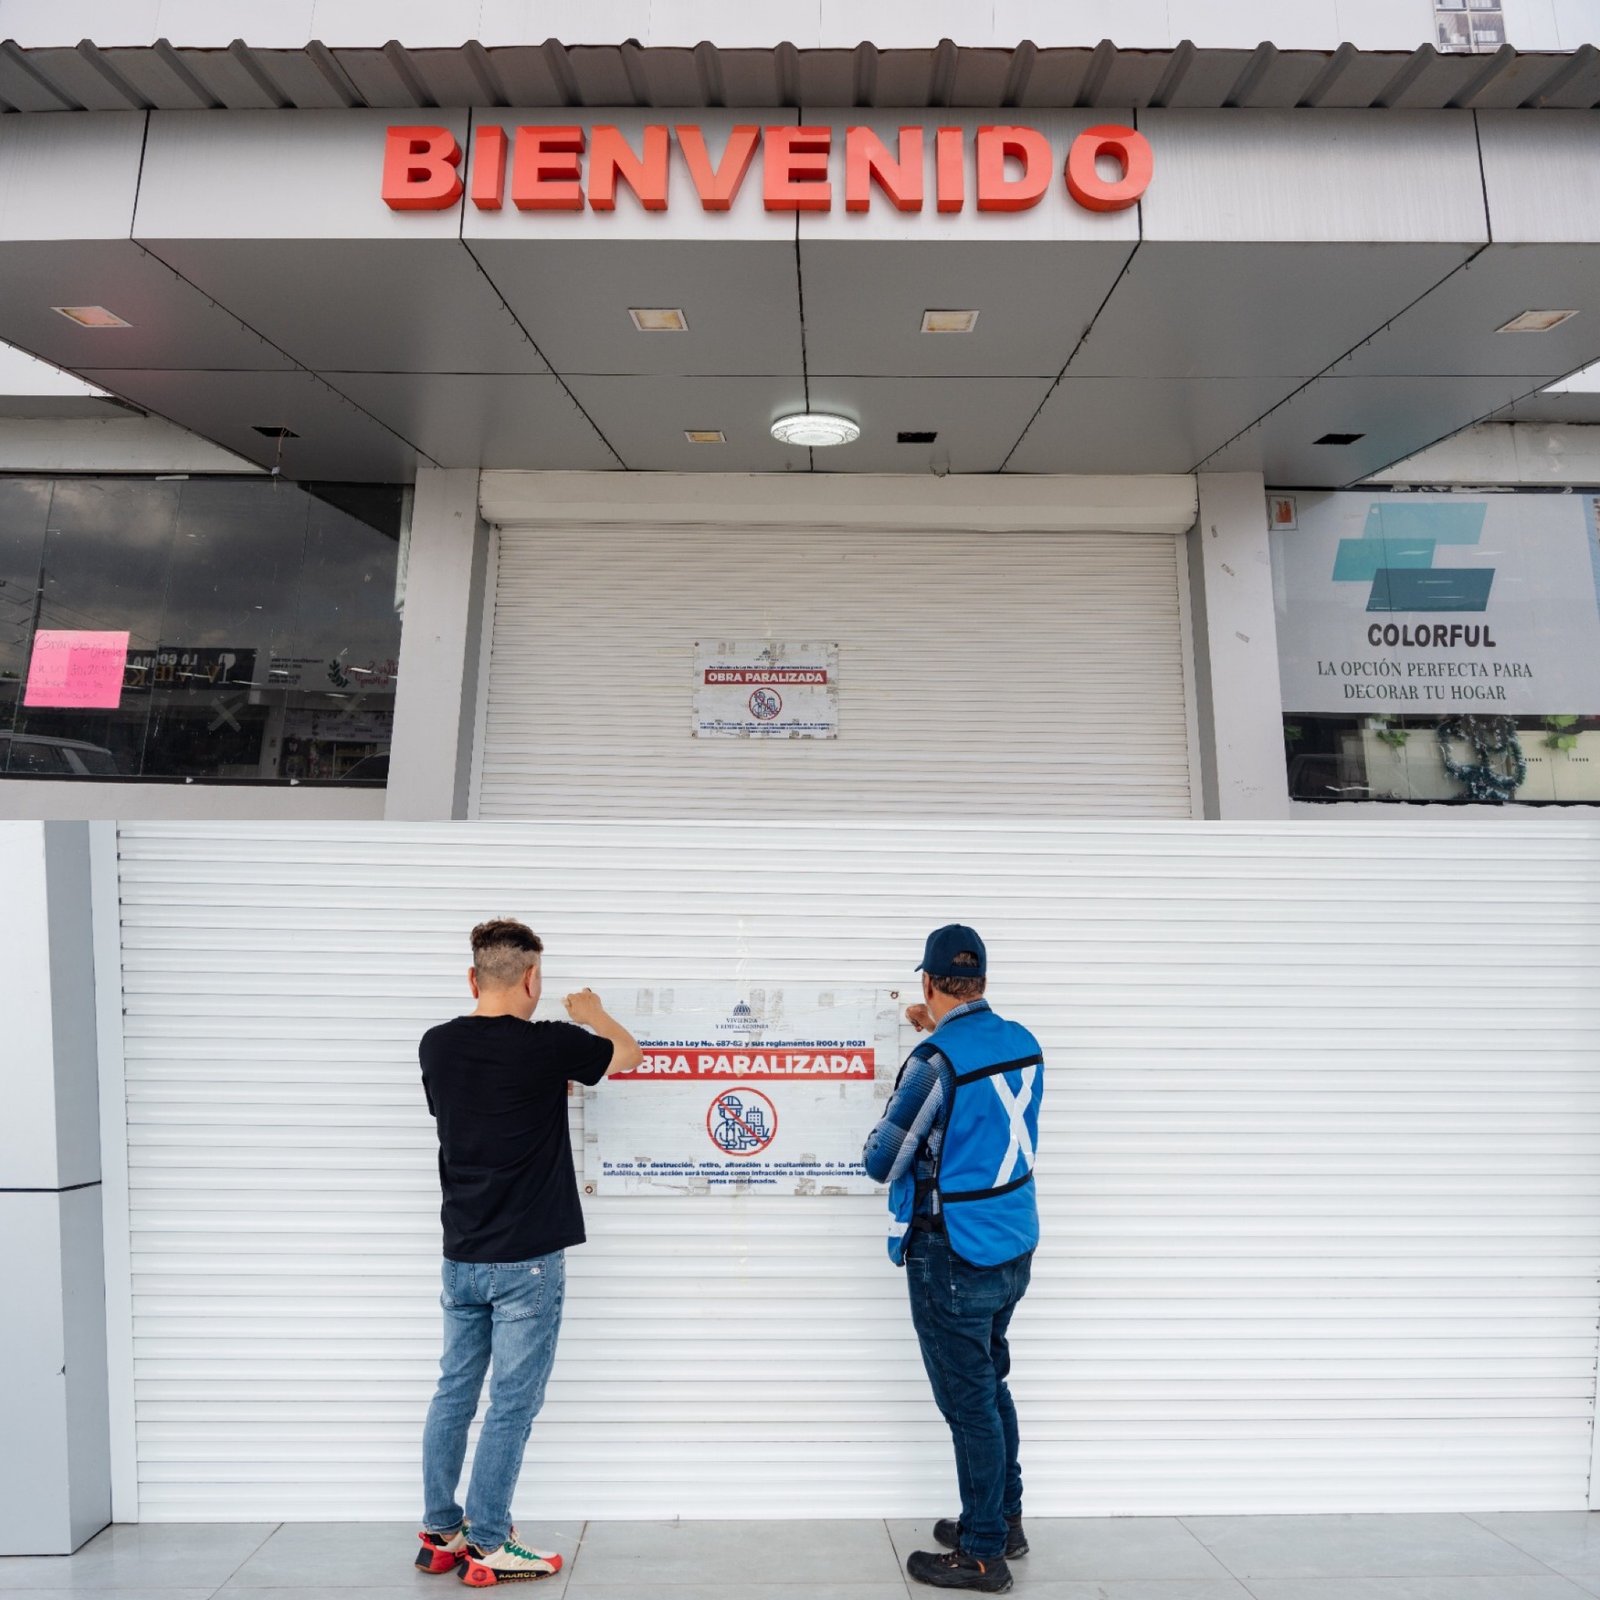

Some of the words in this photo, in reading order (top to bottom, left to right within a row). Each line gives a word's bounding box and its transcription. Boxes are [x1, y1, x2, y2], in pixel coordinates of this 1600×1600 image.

[382, 124, 1153, 213] BIENVENIDO
[1367, 623, 1497, 648] COLORFUL
[708, 672, 743, 682] OBRA
[745, 672, 824, 682] PARALIZADA
[1317, 661, 1337, 676] LA
[1340, 658, 1401, 677] OPCIÓN
[1407, 662, 1489, 677] PERFECTA
[1493, 662, 1533, 678] PARA
[1343, 683, 1420, 700] DECORAR
[1423, 685, 1445, 700] TU
[1451, 685, 1506, 700] HOGAR
[686, 1040, 699, 1048] Ley
[766, 1040, 815, 1048] reglamentos
[622, 1055, 692, 1074] BRA
[698, 1055, 868, 1074] PARALIZADA
